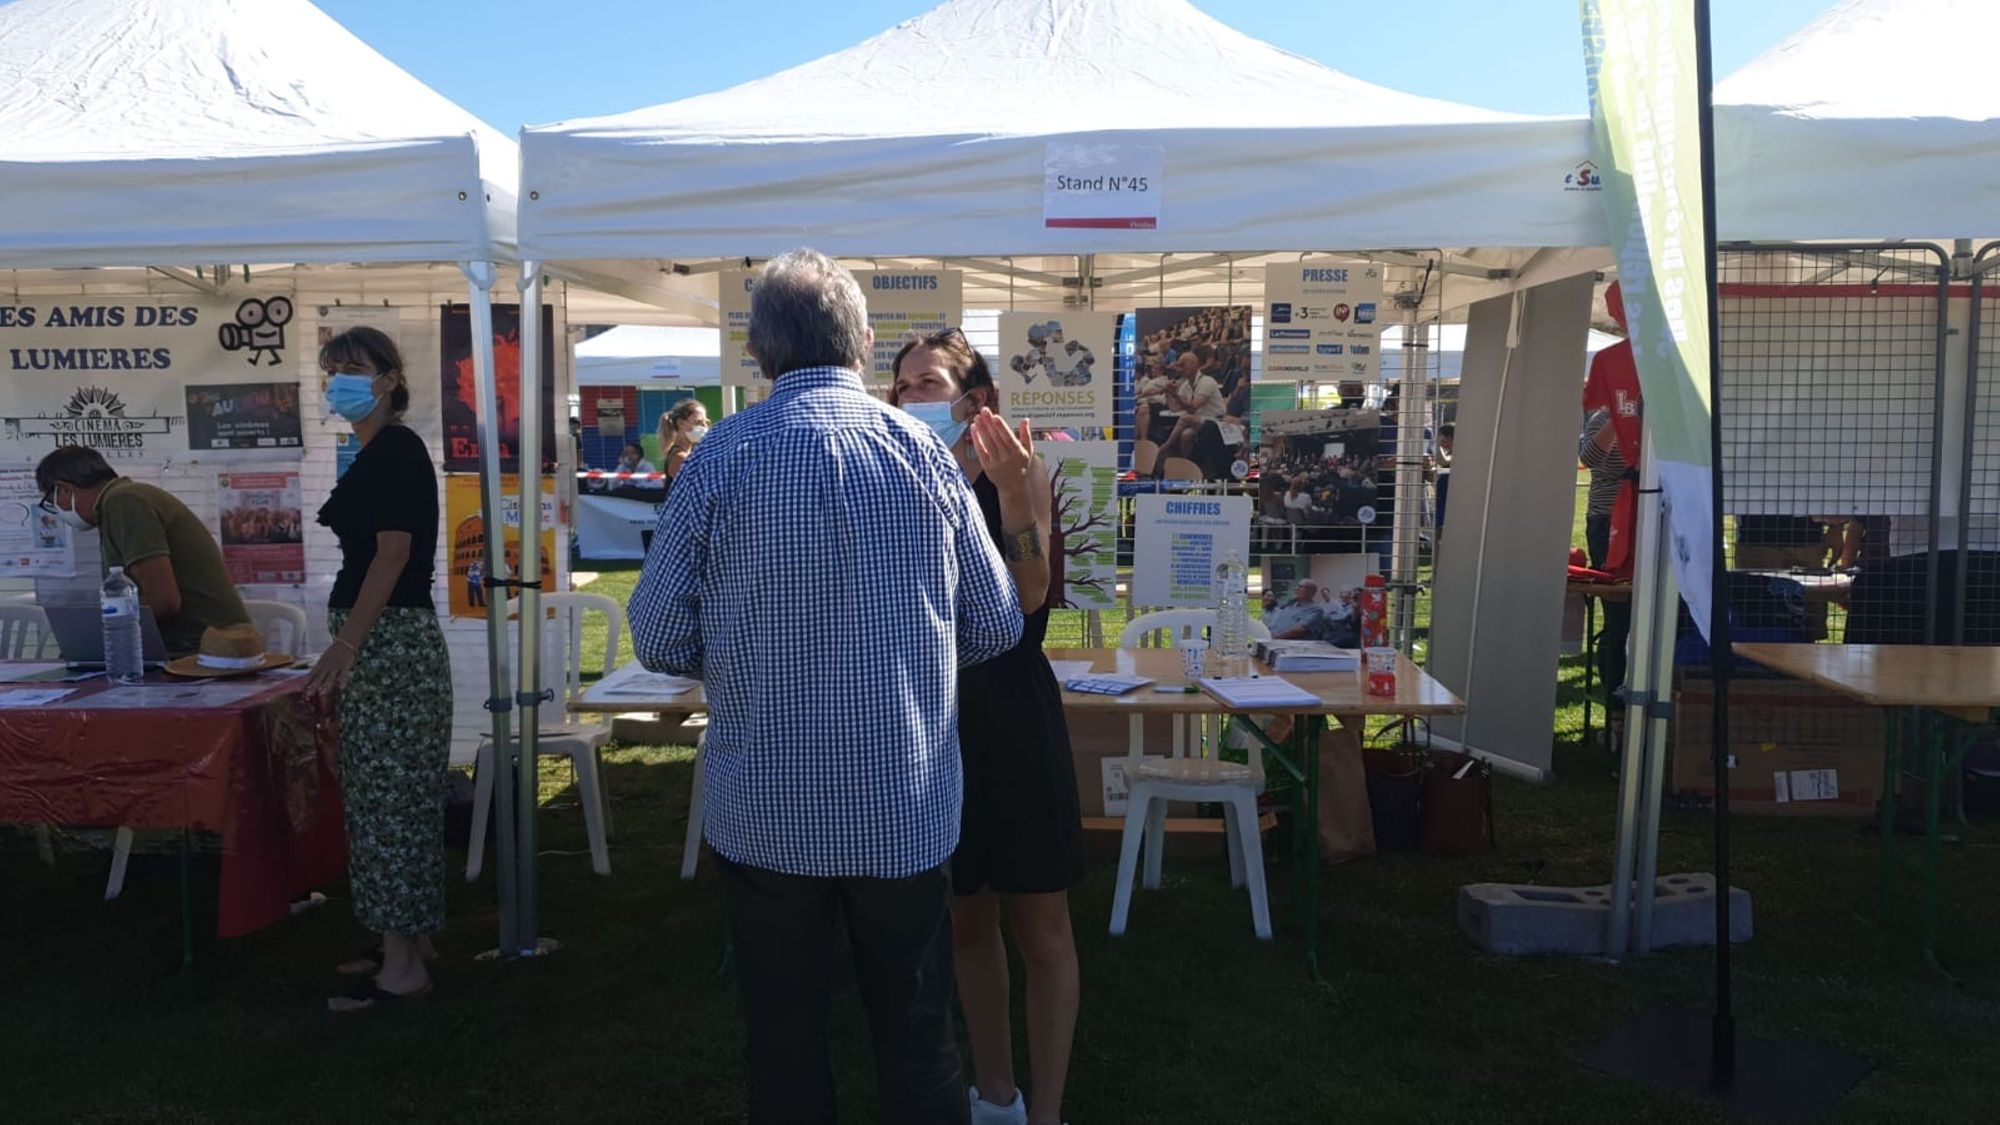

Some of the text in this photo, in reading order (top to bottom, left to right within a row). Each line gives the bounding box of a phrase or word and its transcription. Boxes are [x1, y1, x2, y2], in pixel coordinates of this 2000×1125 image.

[1056, 174, 1148, 192] Stand N°45
[872, 275, 938, 290] OBJECTIFS
[1302, 268, 1349, 282] PRESSE
[0, 306, 199, 327] ES AMIS DES
[10, 348, 171, 370] LUMIERES
[1010, 389, 1096, 405] RÉPONSES
[53, 433, 78, 448] LES
[1166, 501, 1221, 515] CHIFFRES
